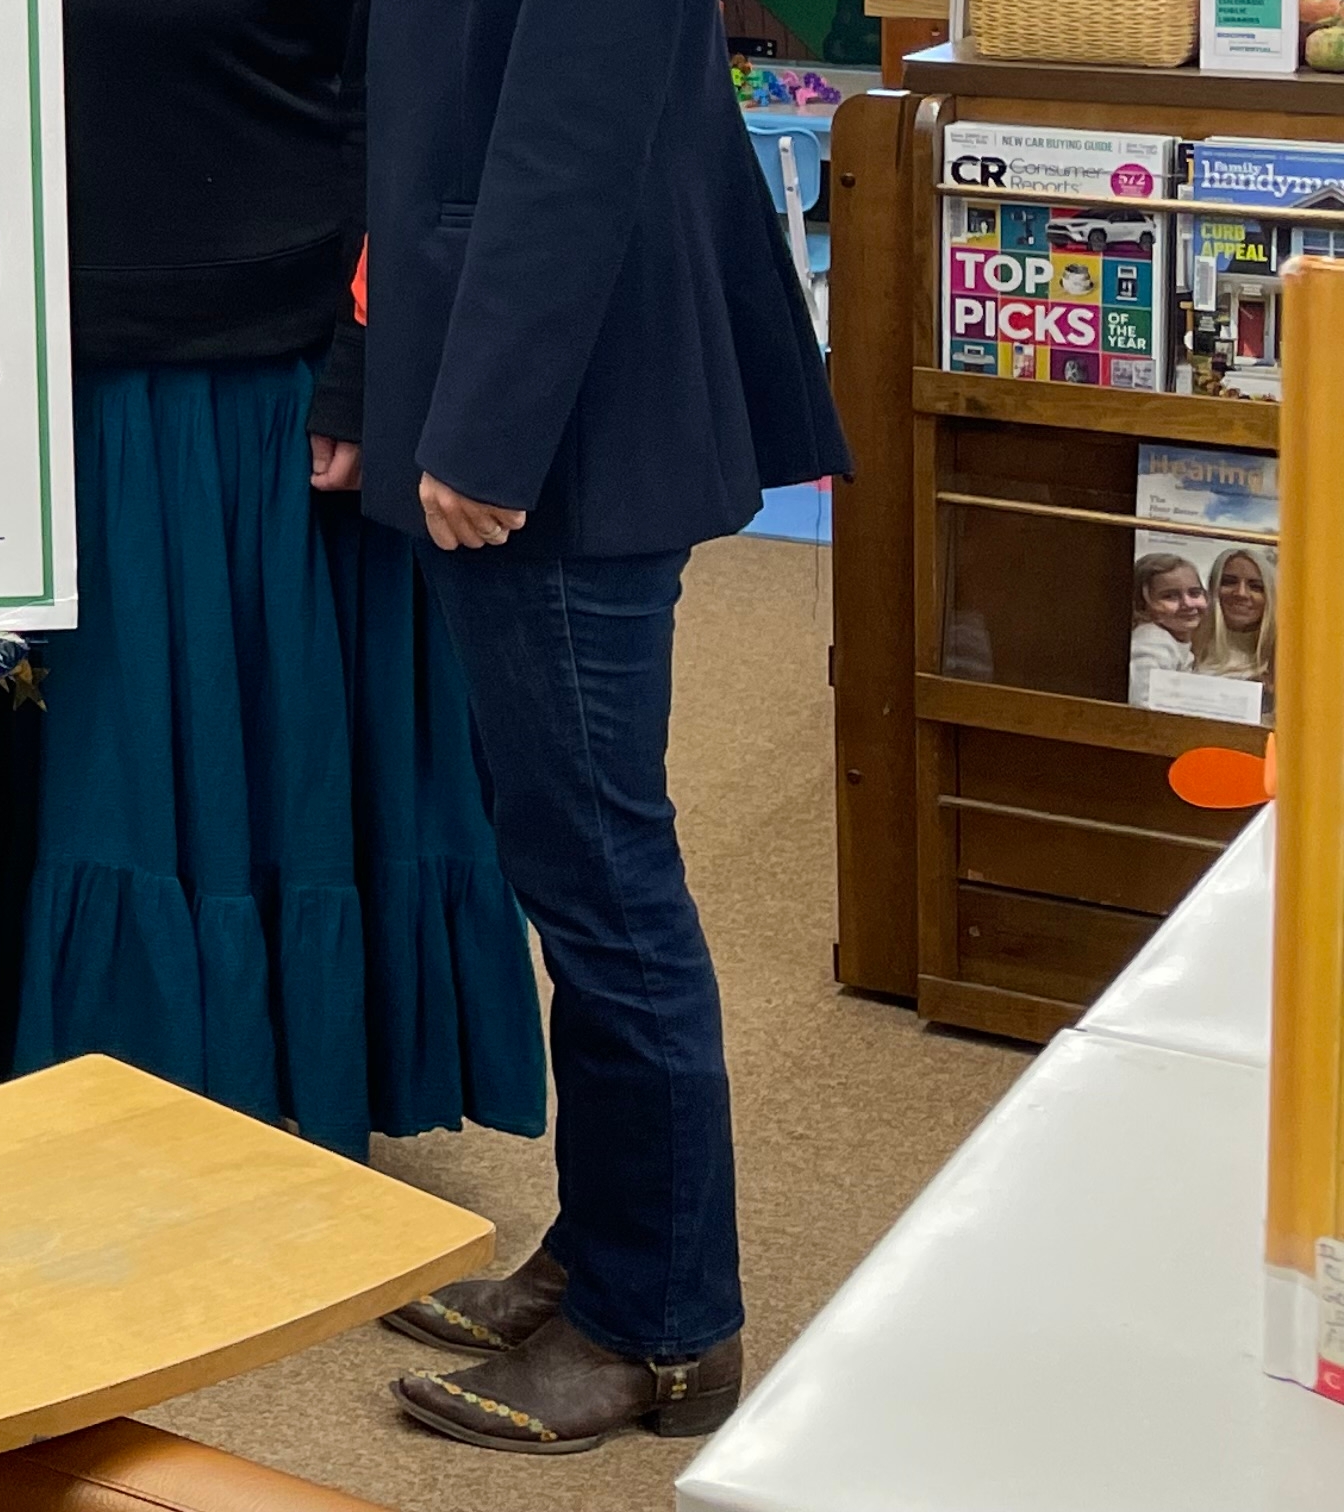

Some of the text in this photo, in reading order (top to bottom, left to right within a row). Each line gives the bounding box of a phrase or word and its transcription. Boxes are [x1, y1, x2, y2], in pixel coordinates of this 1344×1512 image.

[1002, 135, 1023, 147] NEW
[1026, 137, 1044, 148] CAR
[1046, 138, 1082, 150] BUYING
[1084, 141, 1112, 152] GUIDE
[951, 154, 1007, 188] CR
[1010, 157, 1104, 179] Consumer
[1214, 160, 1262, 175] Family
[1011, 175, 1081, 194] Reports
[1118, 172, 1146, 187] 572
[1201, 223, 1246, 241] CURB
[1201, 240, 1268, 262] APPEAL
[956, 251, 1054, 294] TOP
[955, 298, 1096, 346] PICKS
[1108, 312, 1129, 325] OF
[1108, 323, 1136, 339] THE
[1108, 336, 1146, 350] YEAR
[1149, 452, 1264, 493] Hearing
